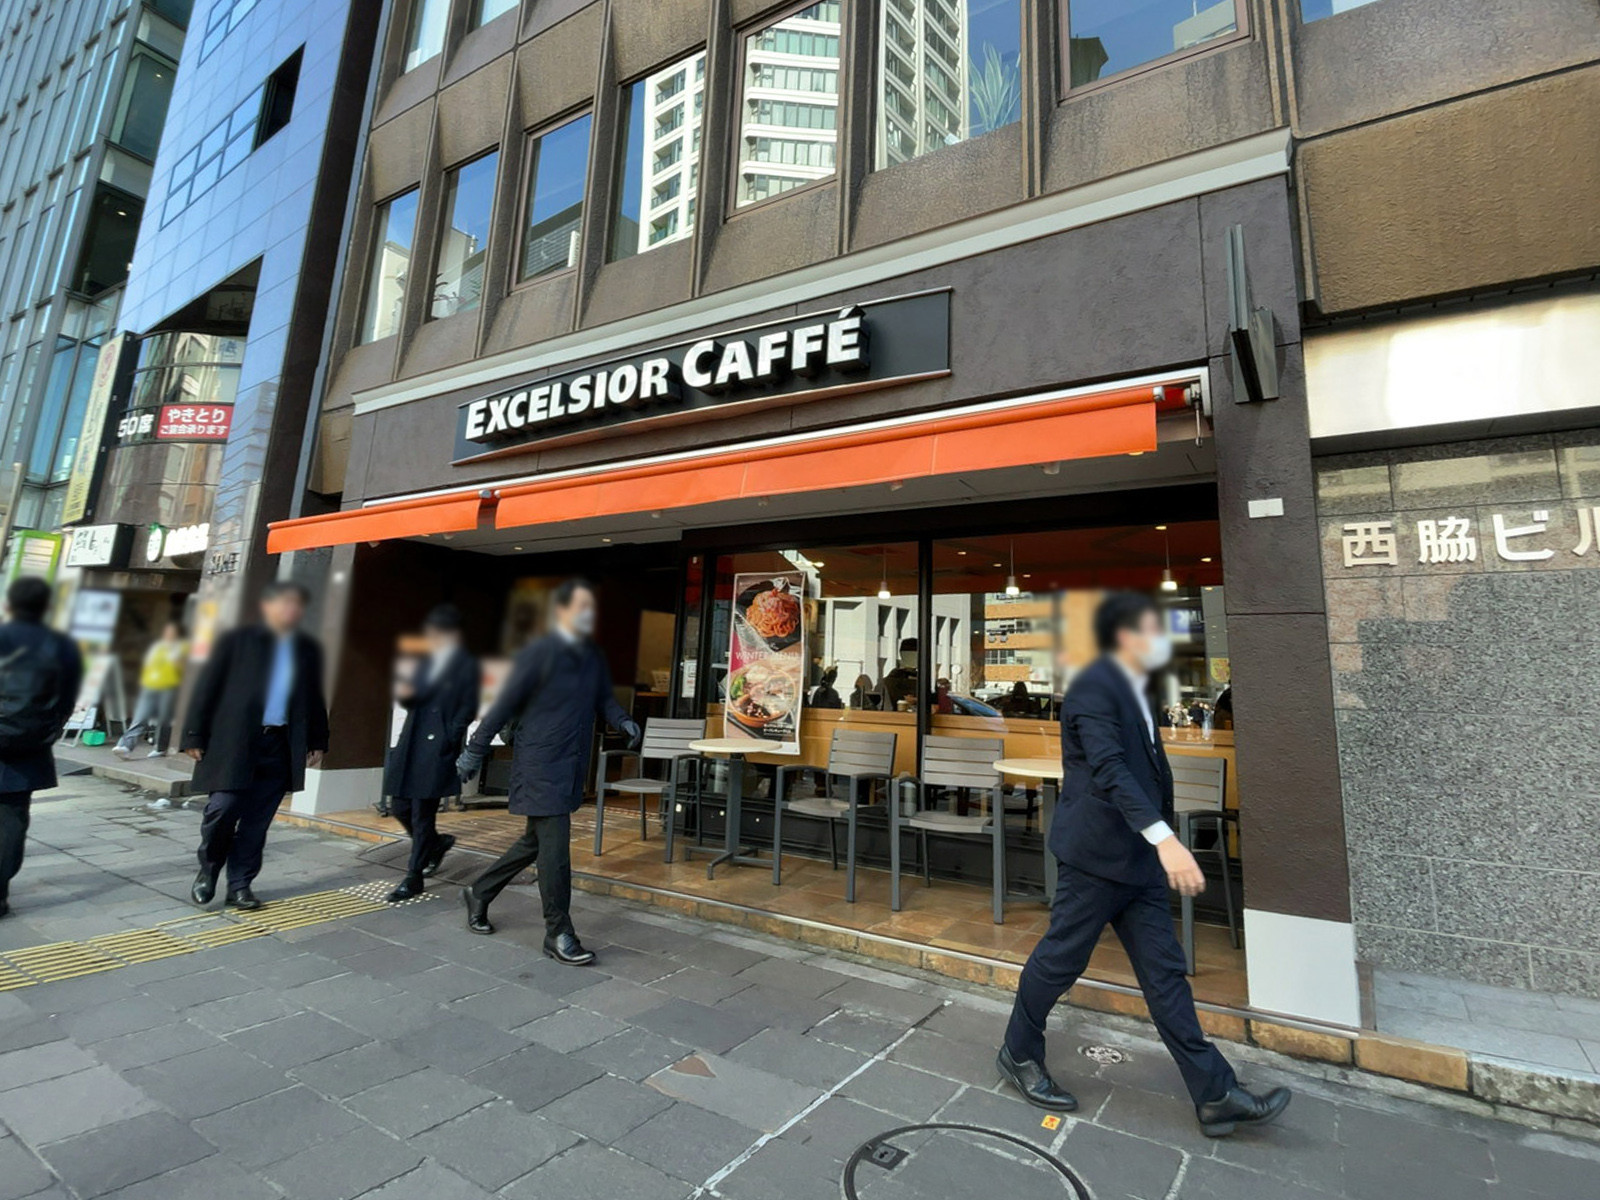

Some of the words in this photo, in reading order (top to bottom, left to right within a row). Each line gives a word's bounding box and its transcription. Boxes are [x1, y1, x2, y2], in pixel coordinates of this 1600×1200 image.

[465, 357, 670, 441] EXCELSIOR
[682, 305, 864, 388] CAFFÉ
[167, 408, 225, 423] やきとり
